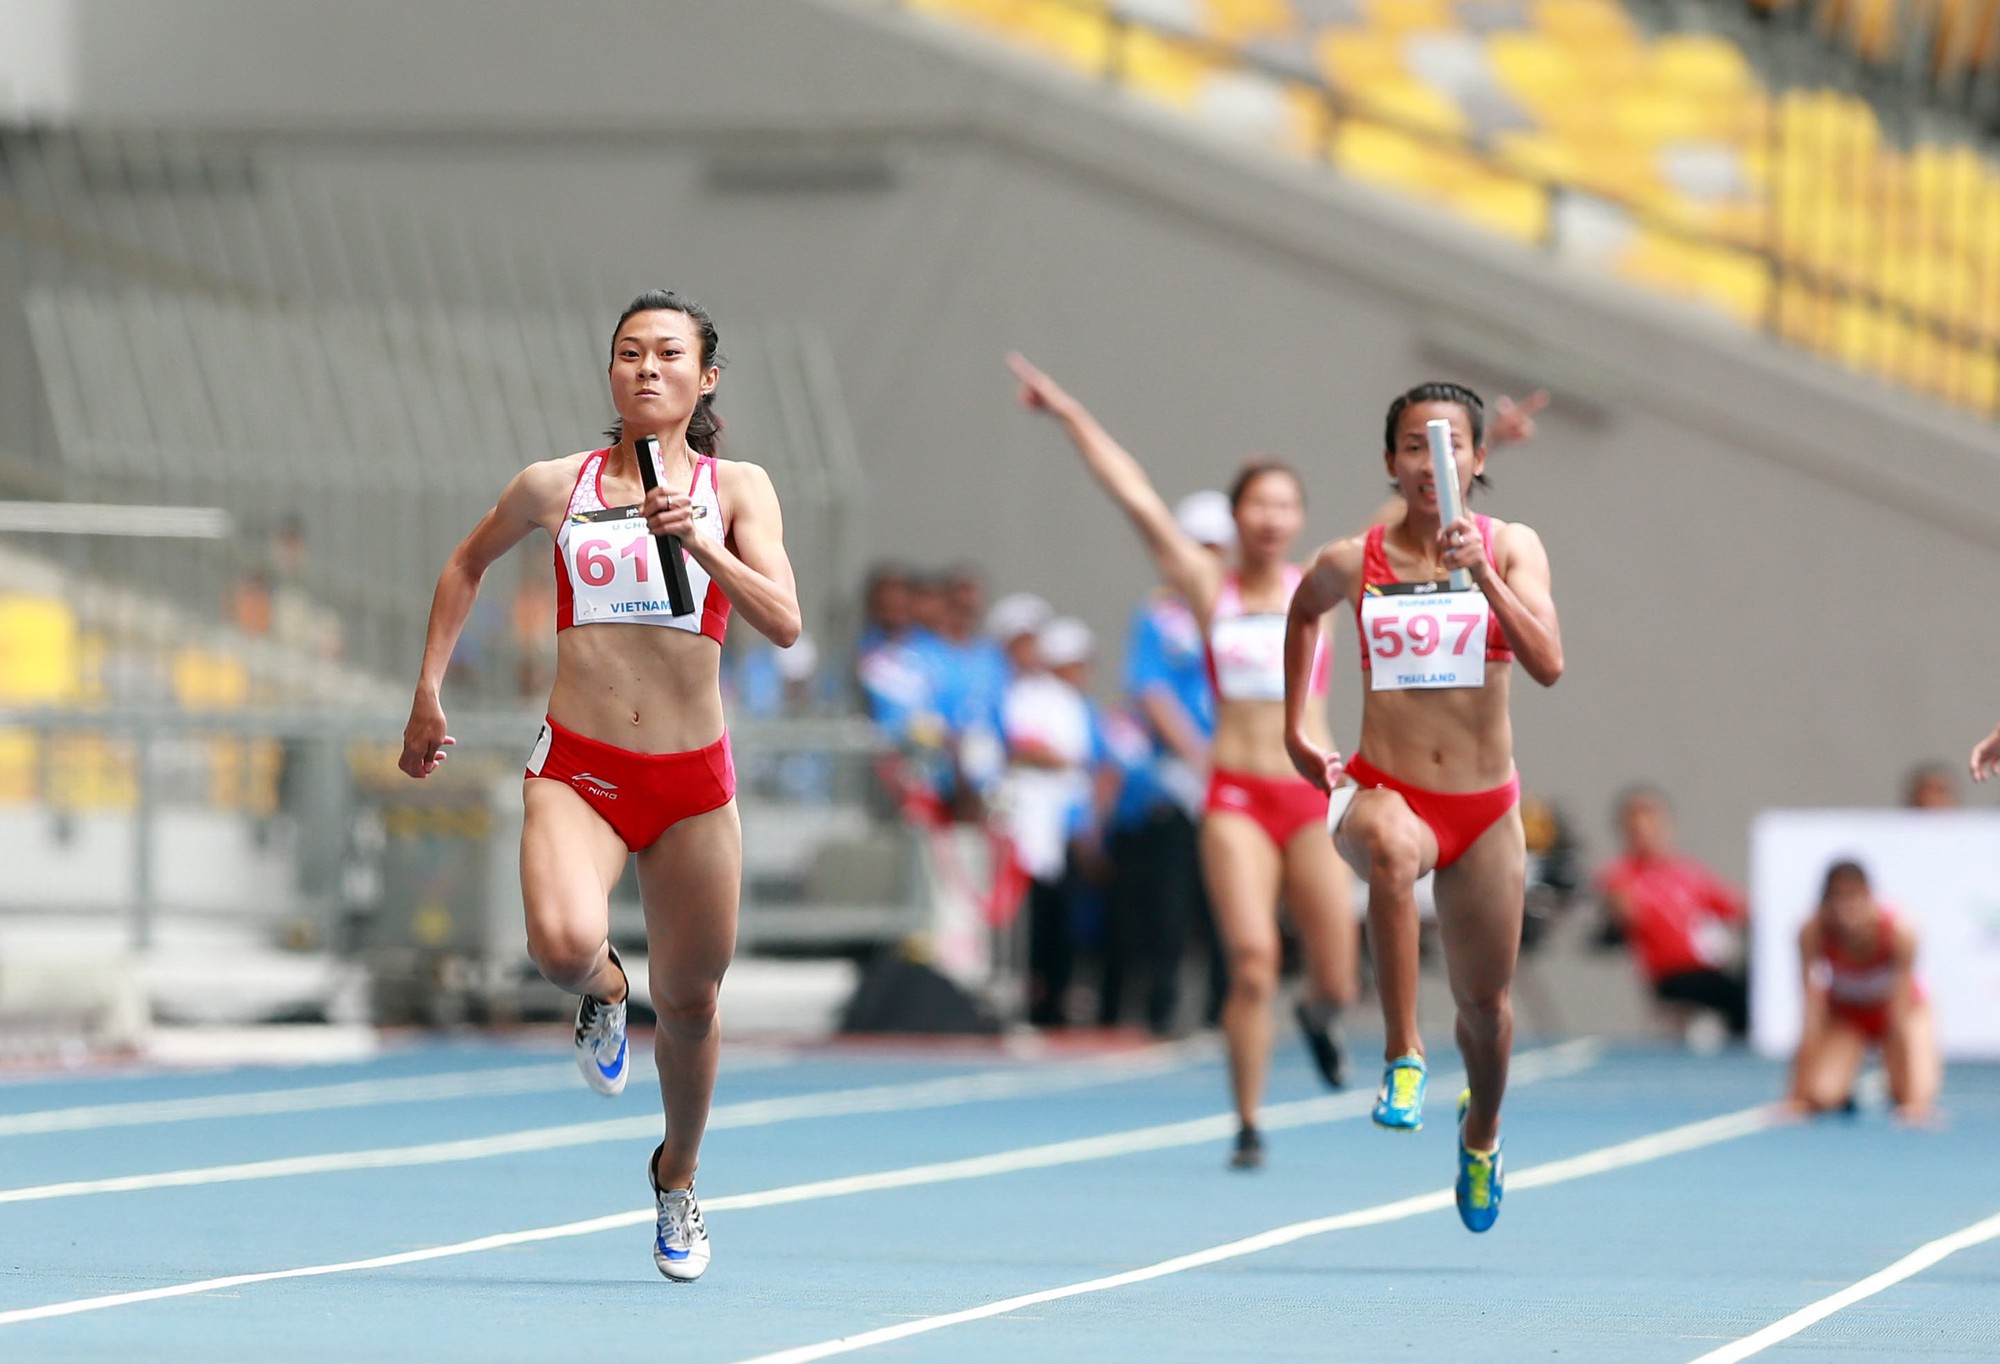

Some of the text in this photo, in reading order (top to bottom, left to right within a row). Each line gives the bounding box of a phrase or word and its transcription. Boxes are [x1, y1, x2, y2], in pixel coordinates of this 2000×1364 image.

[576, 537, 691, 587] 61
[1372, 614, 1481, 658] 597
[1397, 673, 1456, 685] THAILAND
